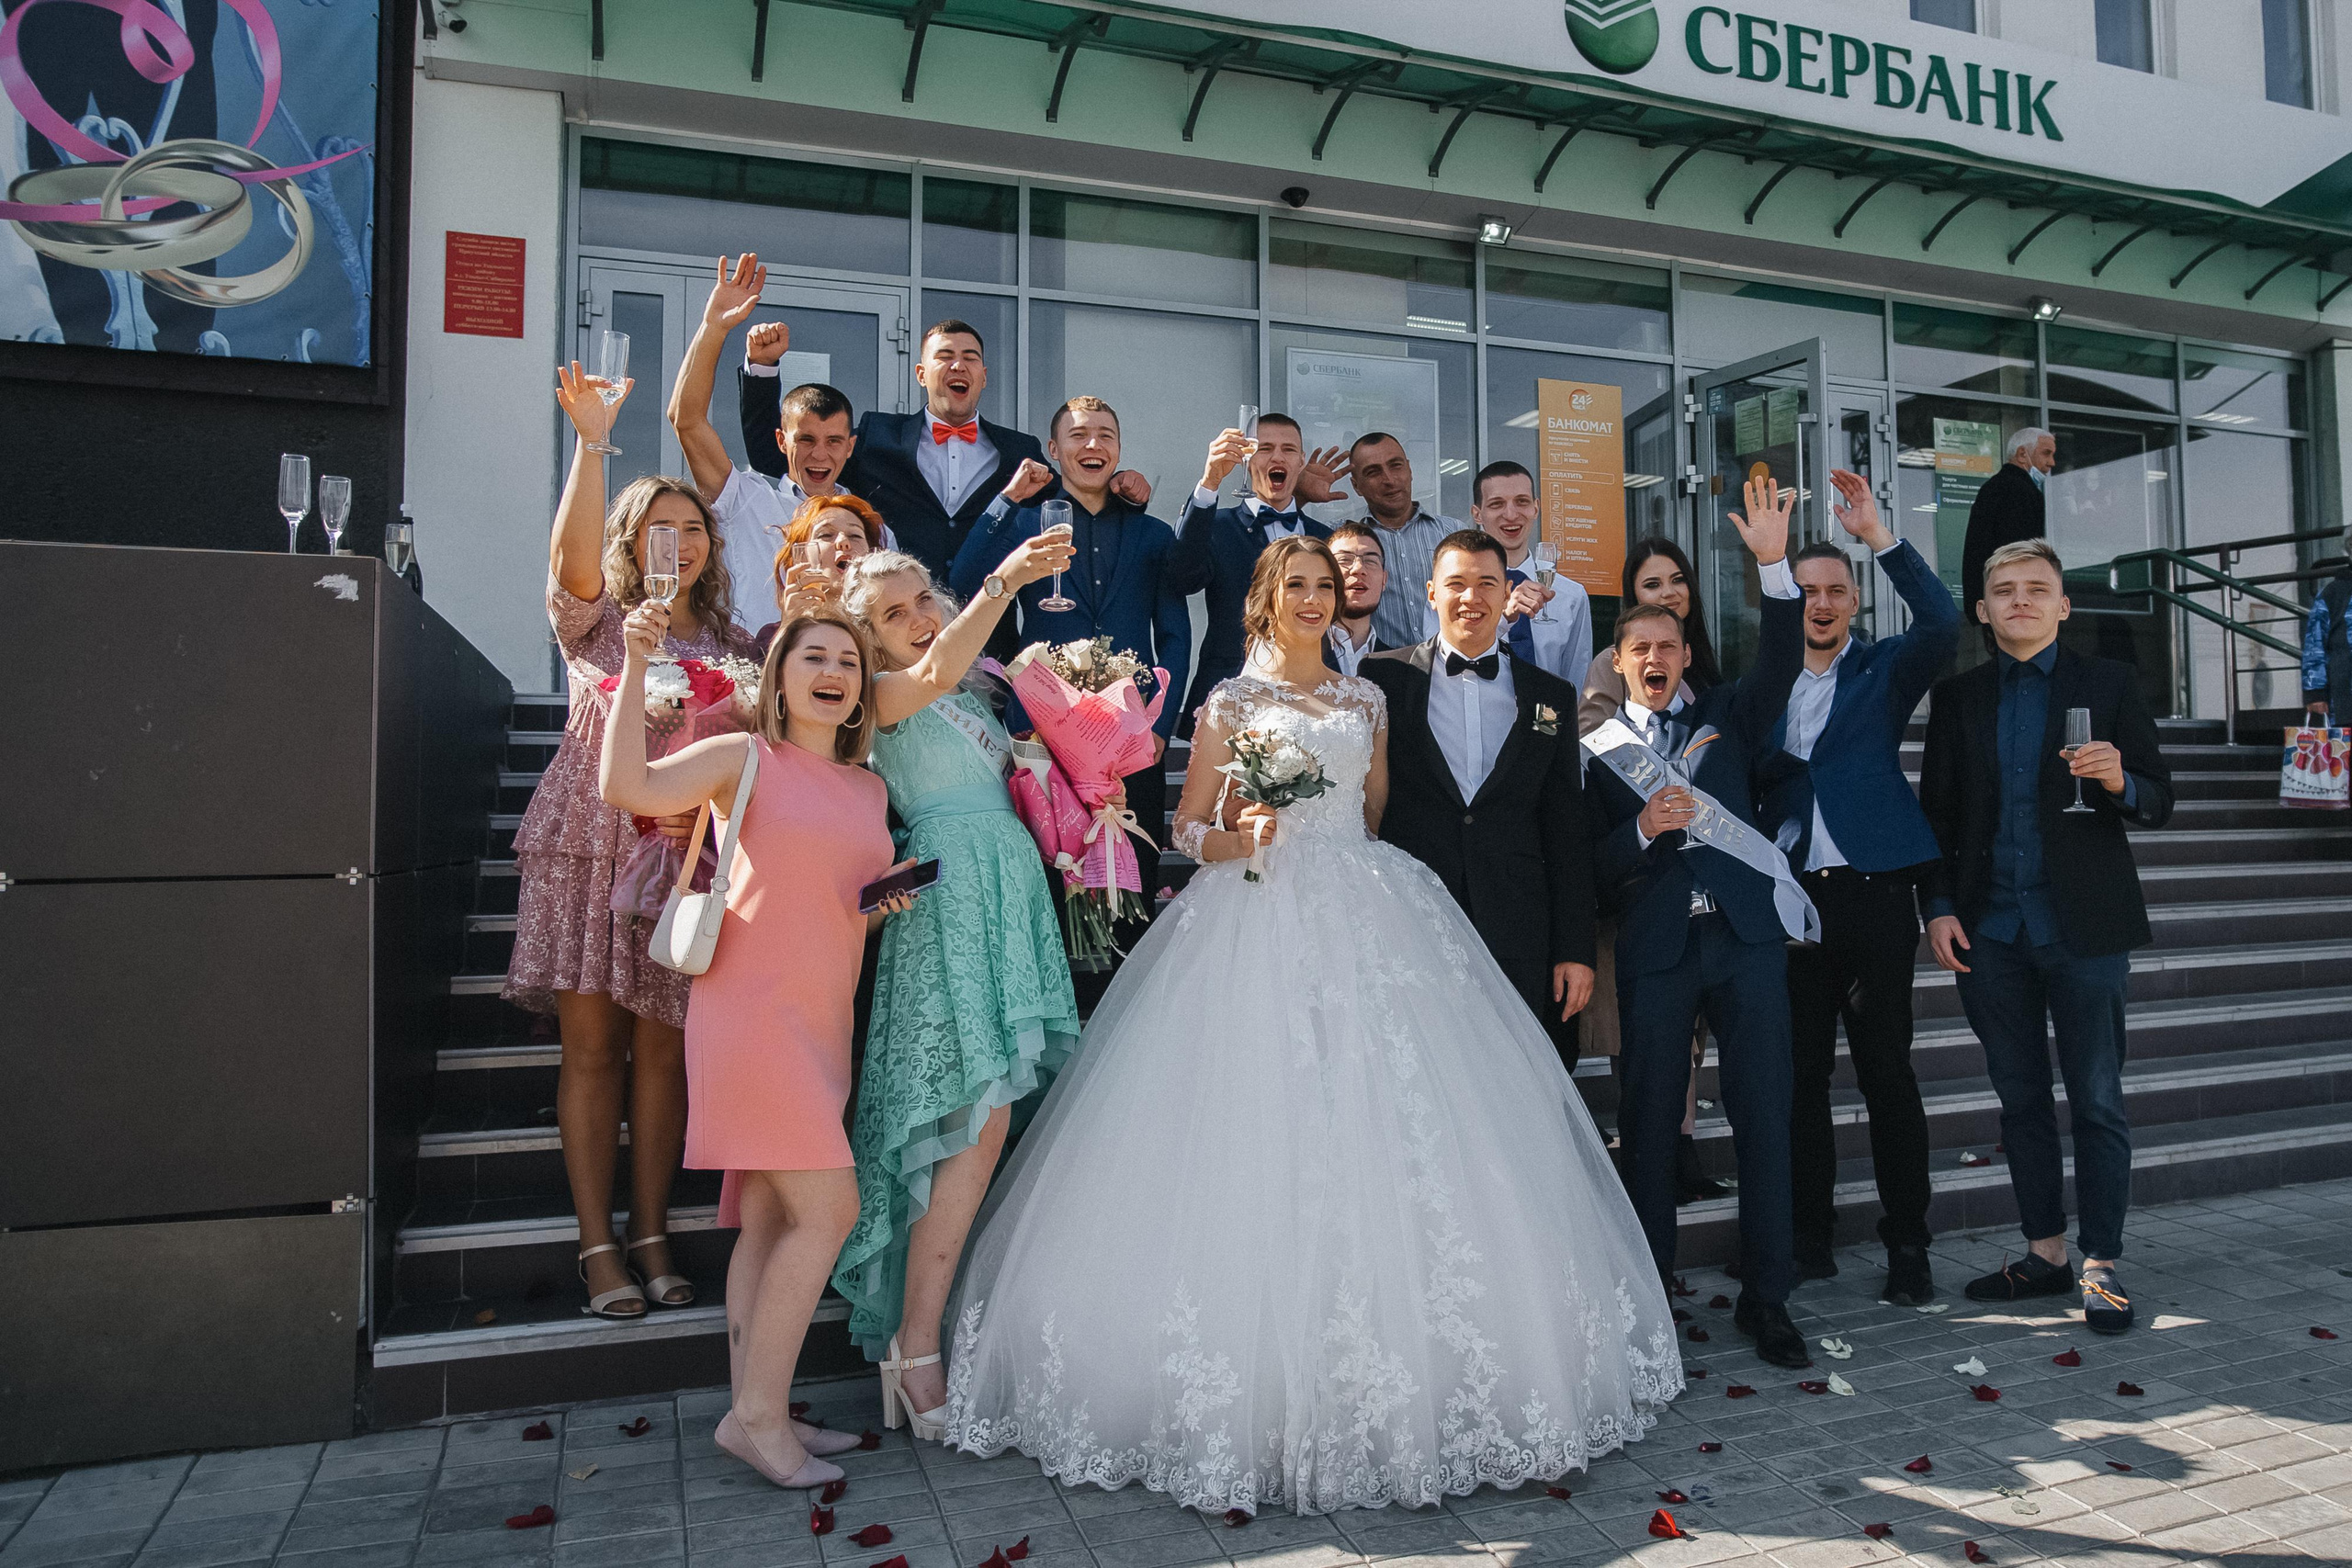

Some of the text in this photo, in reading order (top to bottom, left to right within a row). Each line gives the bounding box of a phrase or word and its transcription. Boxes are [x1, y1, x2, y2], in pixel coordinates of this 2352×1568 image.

[1684, 4, 2065, 142] СБЕРБАНК
[1312, 364, 1362, 377] СБЕРБАНК
[1571, 394, 1586, 405] 24
[1547, 417, 1613, 434] БАНКОМАТ
[1549, 471, 1583, 479] ОПЛАТИТЬ
[1565, 516, 1597, 525] ПОГАШЕНИЕ
[1565, 522, 1592, 530] КРЕДИТОВ
